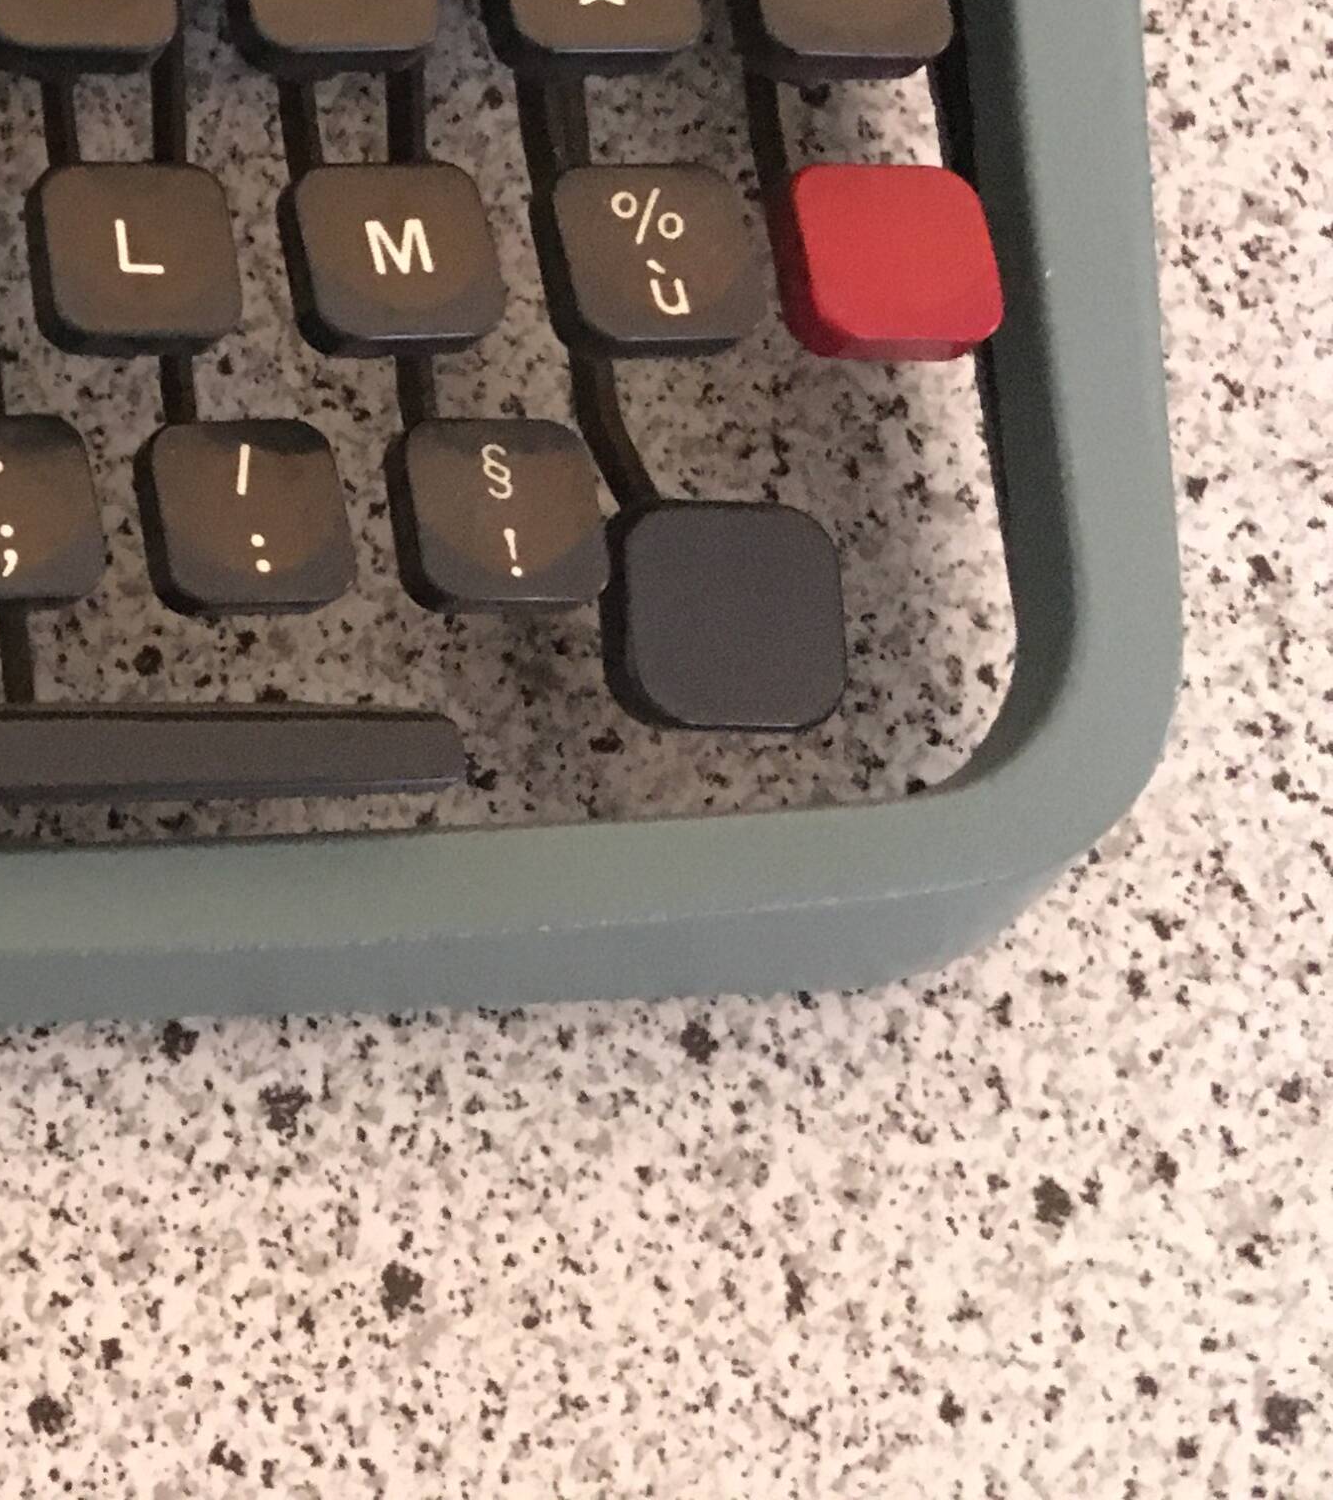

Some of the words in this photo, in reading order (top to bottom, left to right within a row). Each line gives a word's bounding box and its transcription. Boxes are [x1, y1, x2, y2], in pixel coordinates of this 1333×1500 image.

[608, 185, 686, 247] %
[112, 216, 167, 277] L
[362, 216, 437, 277] M
[644, 257, 692, 317] ù
[479, 442, 515, 502] §
[248, 531, 273, 575] :
[501, 526, 525, 579] !
